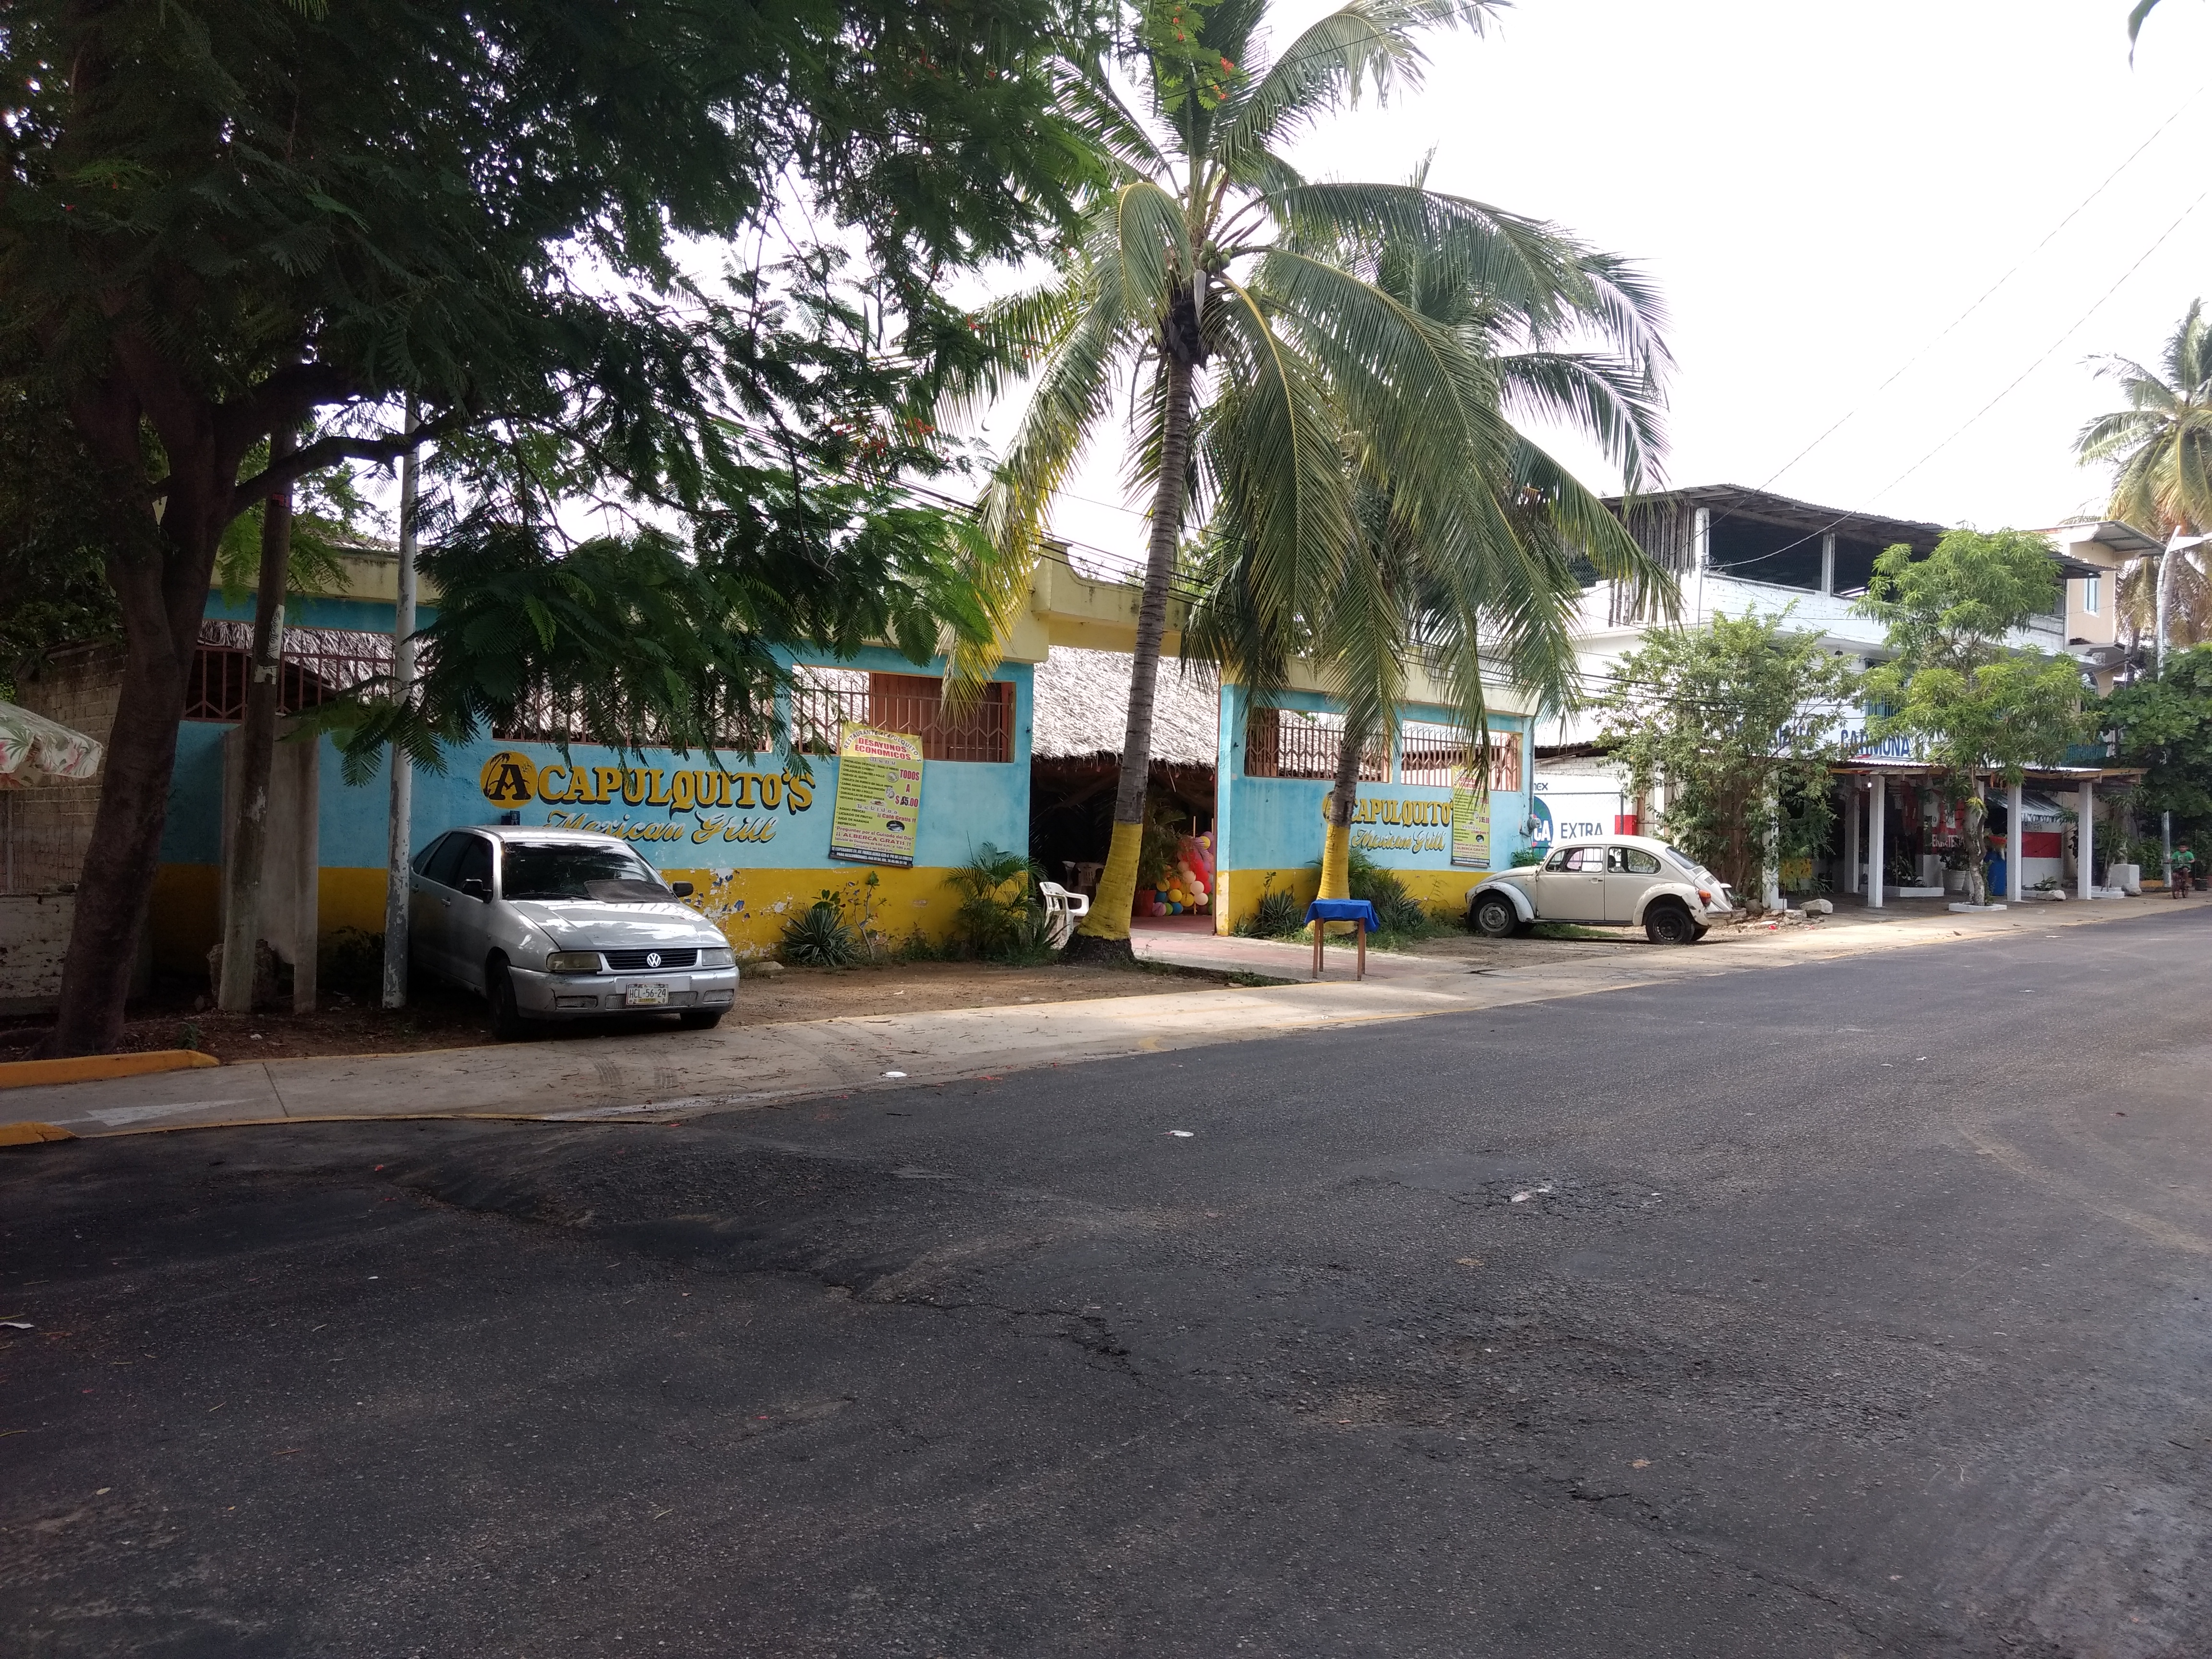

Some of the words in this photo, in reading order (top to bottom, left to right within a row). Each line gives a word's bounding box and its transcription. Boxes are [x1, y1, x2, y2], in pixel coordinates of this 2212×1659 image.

[844, 730, 878, 749] RESTAURANTE
[858, 737, 907, 753] DESAYUNOS
[854, 745, 912, 760] ECONOMICOS
[900, 769, 920, 781] TODOS
[489, 764, 816, 820] ACAPULQUITO'S
[905, 784, 910, 793] A
[856, 803, 898, 814] Bebidas
[543, 810, 685, 843] Mexican
[691, 811, 779, 845] Grill
[1561, 822, 1603, 839] EXTRA
[843, 833, 878, 842] ALBERCA
[1351, 829, 1413, 852] Mexican
[1412, 830, 1447, 854] Grill
[629, 988, 666, 998] HCL-56-24
